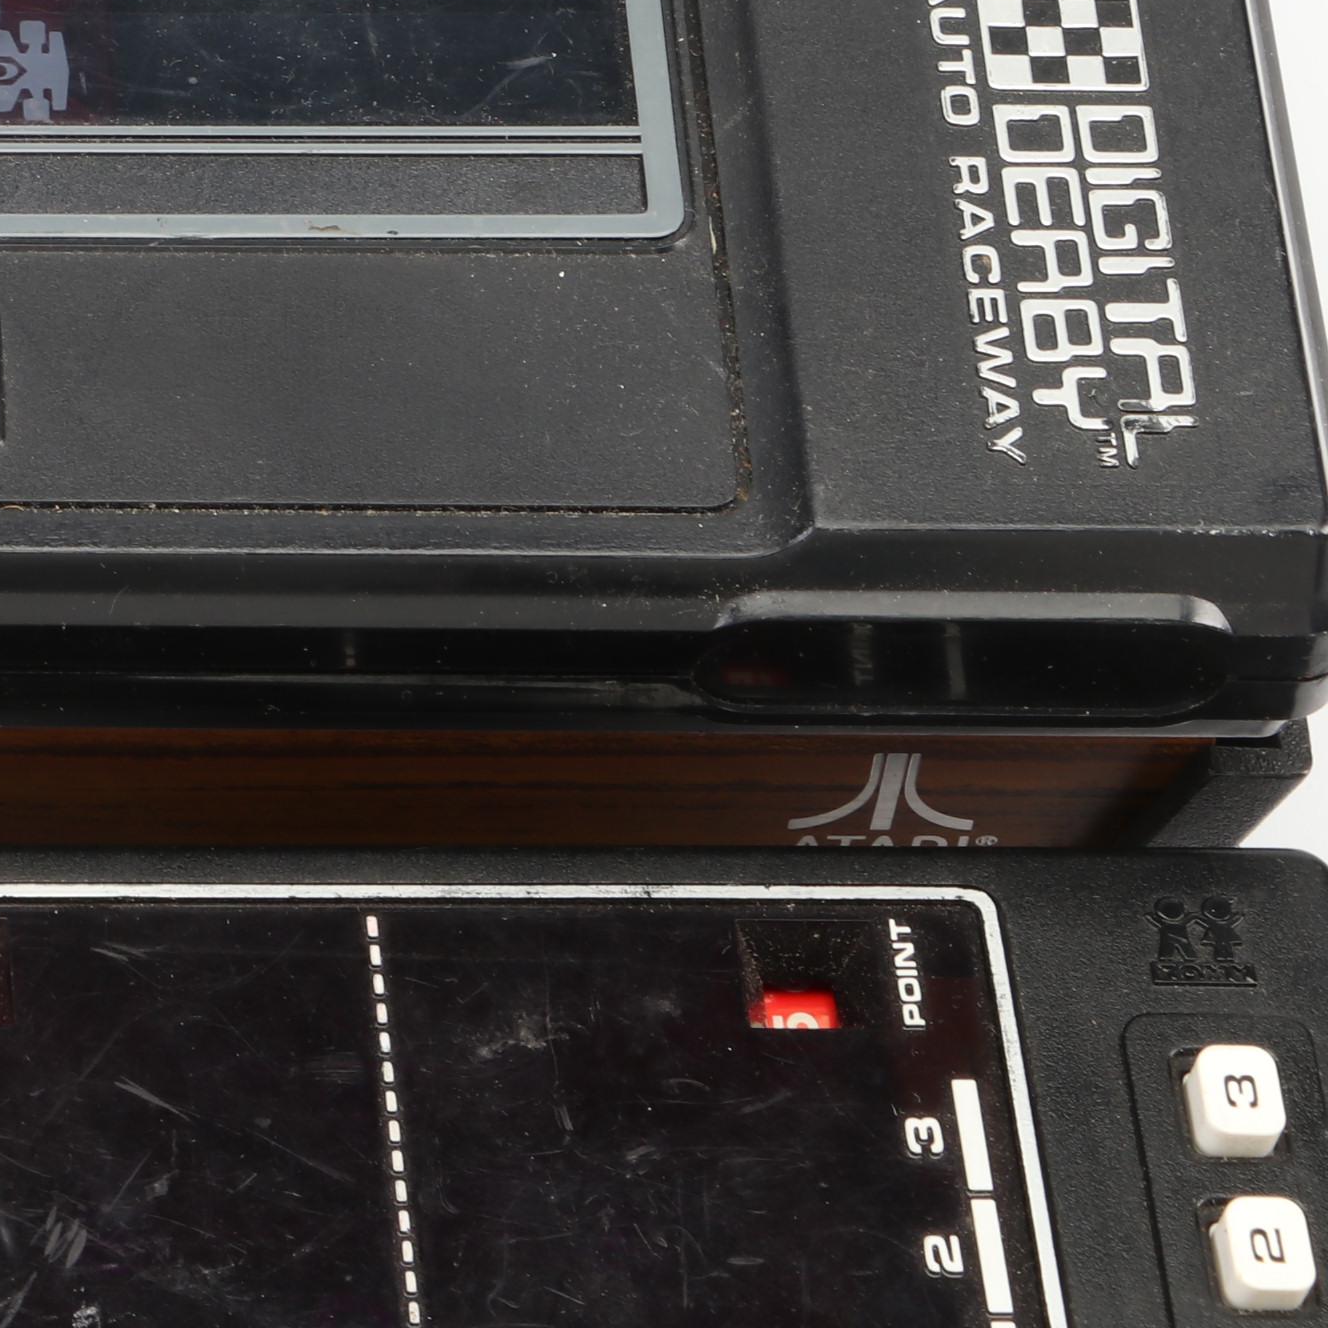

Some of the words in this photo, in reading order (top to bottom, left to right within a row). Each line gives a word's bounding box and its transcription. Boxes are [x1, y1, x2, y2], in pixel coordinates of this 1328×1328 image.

[1075, 103, 1199, 470] DIGITAL
[948, 155, 1027, 466] RACEWAY
[887, 917, 927, 1030] POINT
[1224, 1074, 1260, 1109] 3
[903, 1115, 945, 1157] 3
[924, 1234, 964, 1277] 2
[1250, 1226, 1285, 1265] 2
